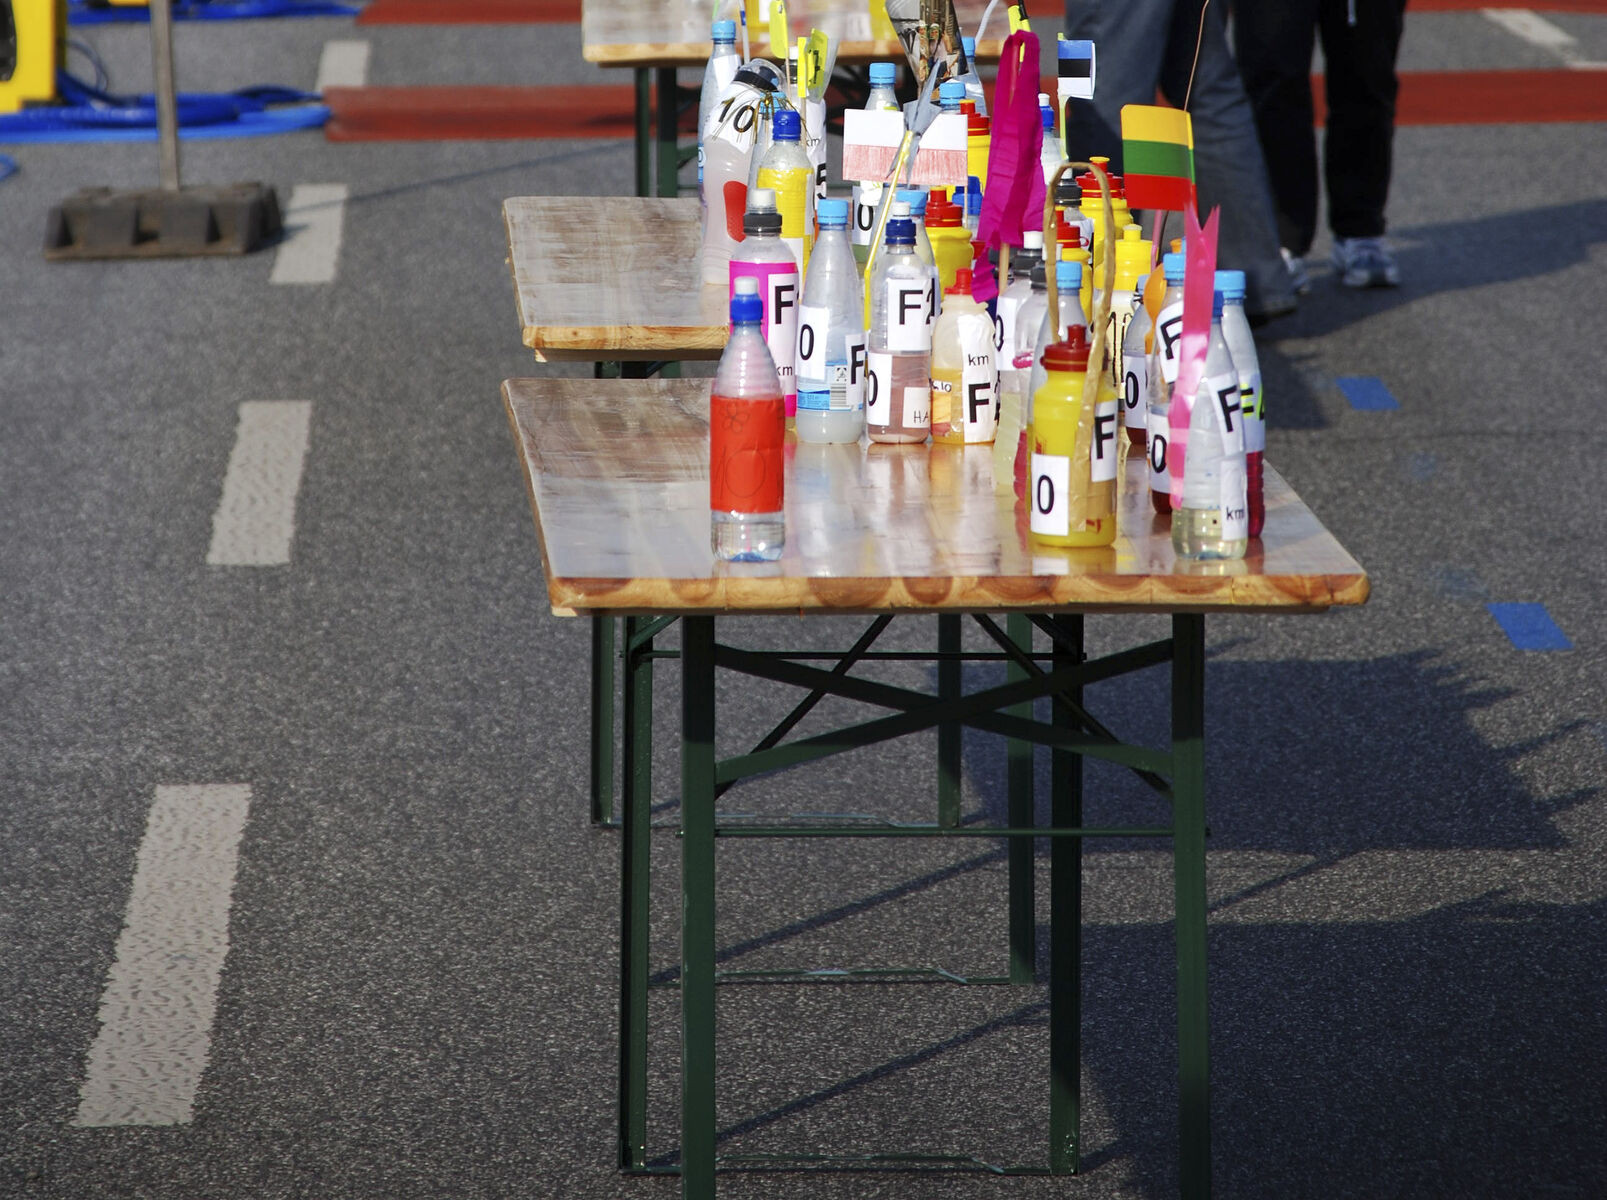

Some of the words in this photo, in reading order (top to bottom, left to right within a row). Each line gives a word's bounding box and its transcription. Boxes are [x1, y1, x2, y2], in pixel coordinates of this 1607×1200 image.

[718, 97, 756, 133] 10
[775, 284, 799, 325] F
[1160, 316, 1182, 360] F
[850, 343, 865, 385] F
[968, 353, 989, 366] km
[1218, 385, 1241, 433] F
[1094, 414, 1115, 460] F
[1226, 507, 1245, 520] km
